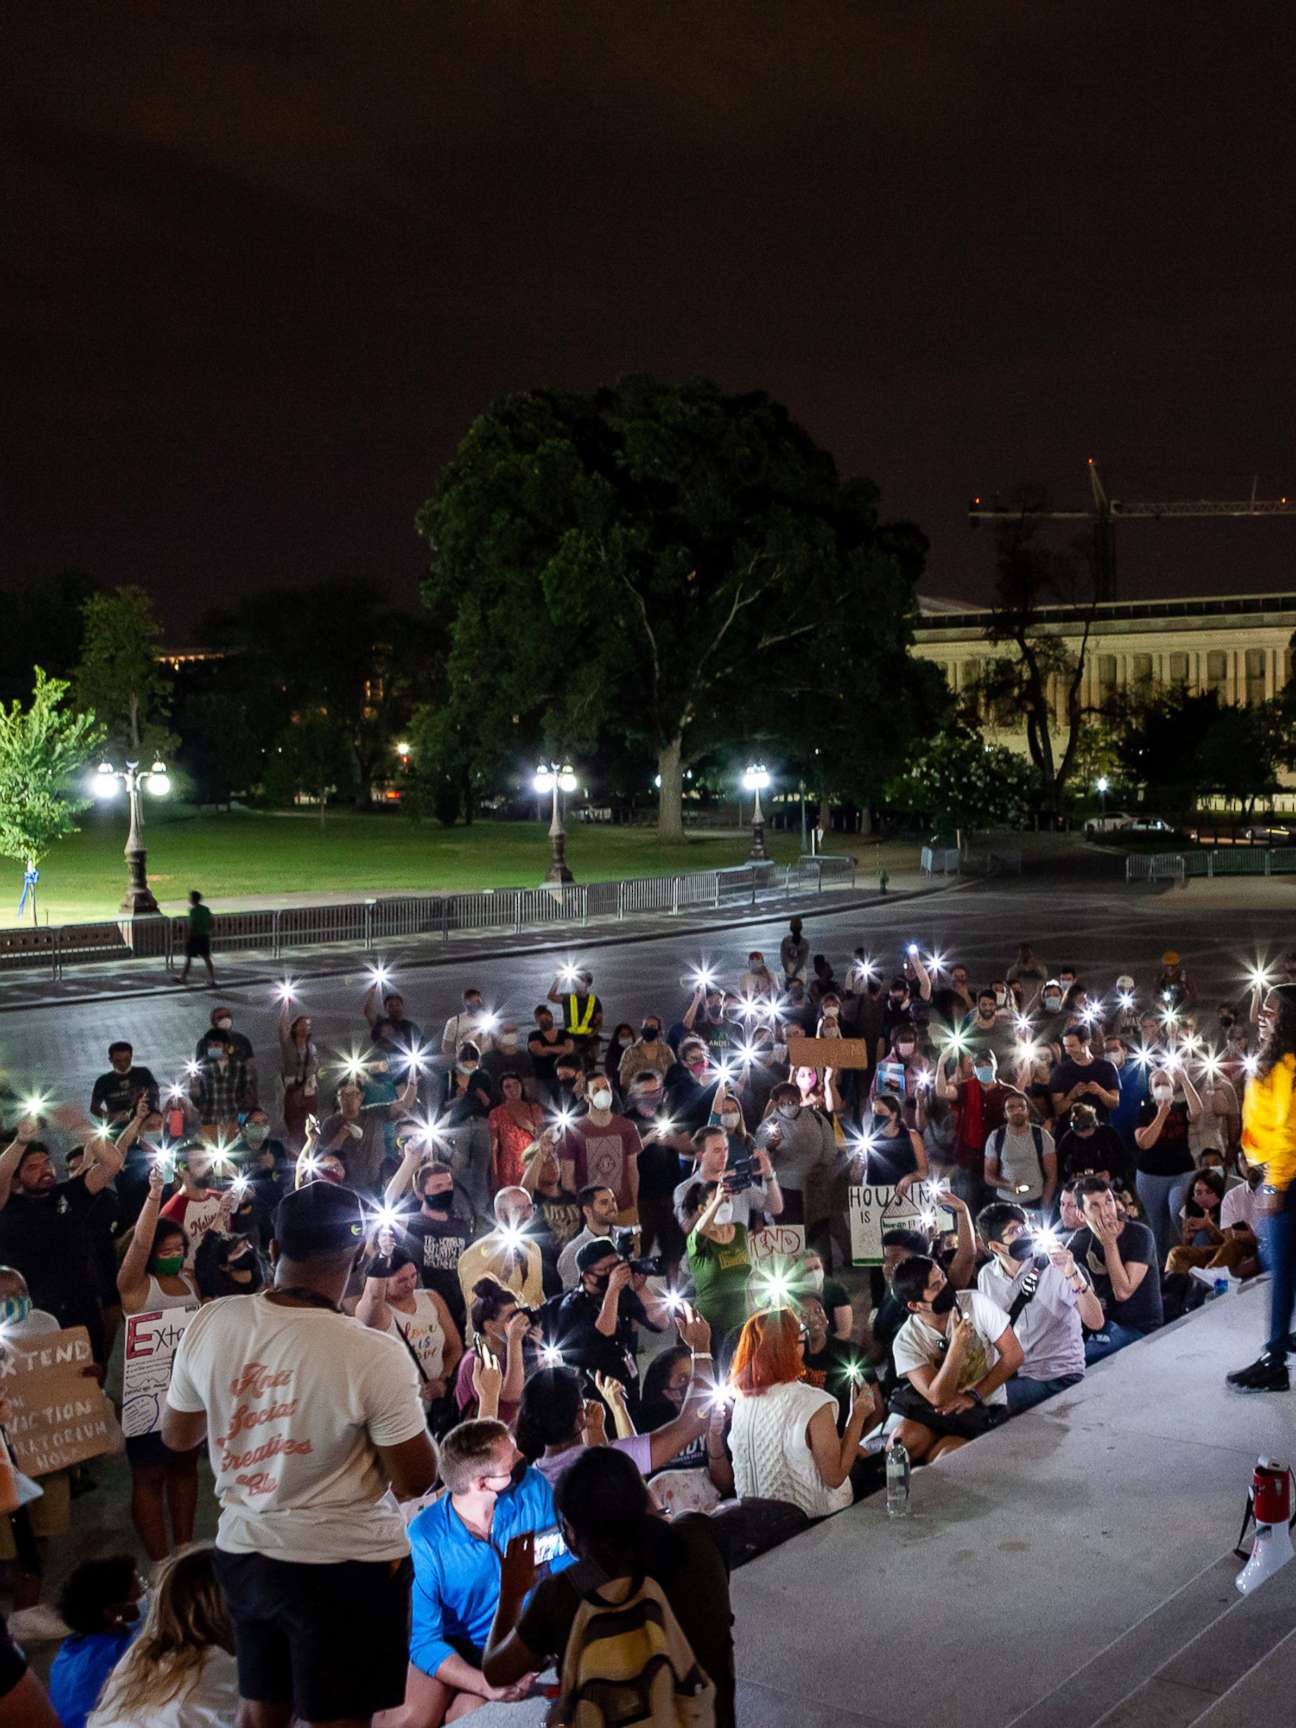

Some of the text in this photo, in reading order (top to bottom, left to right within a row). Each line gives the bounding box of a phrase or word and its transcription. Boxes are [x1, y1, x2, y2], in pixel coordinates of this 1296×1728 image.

[850, 1183, 931, 1209] HOUSIN
[860, 1211, 872, 1225] IS
[126, 1311, 184, 1361] Exte
[0, 1340, 92, 1378] XTEND
